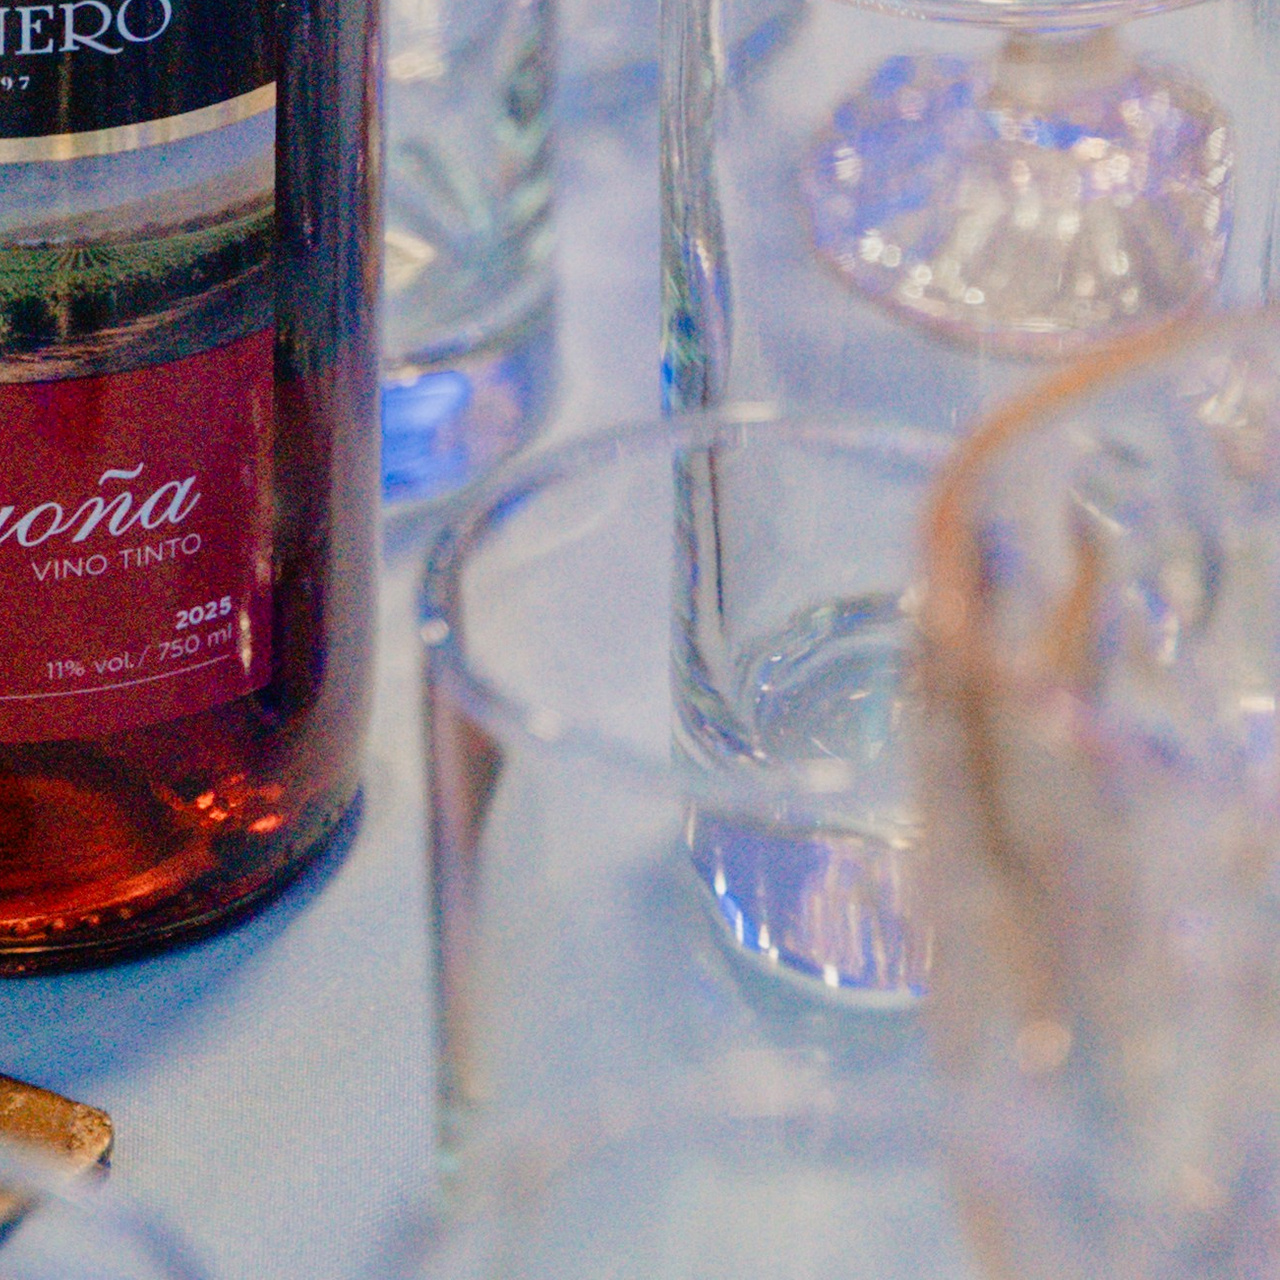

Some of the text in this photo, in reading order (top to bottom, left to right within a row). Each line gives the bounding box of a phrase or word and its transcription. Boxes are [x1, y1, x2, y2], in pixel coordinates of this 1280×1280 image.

[32, 533, 202, 582] VINO TINTO
[176, 595, 232, 630] 2025
[47, 659, 86, 680] 11%
[159, 634, 200, 661] 750
